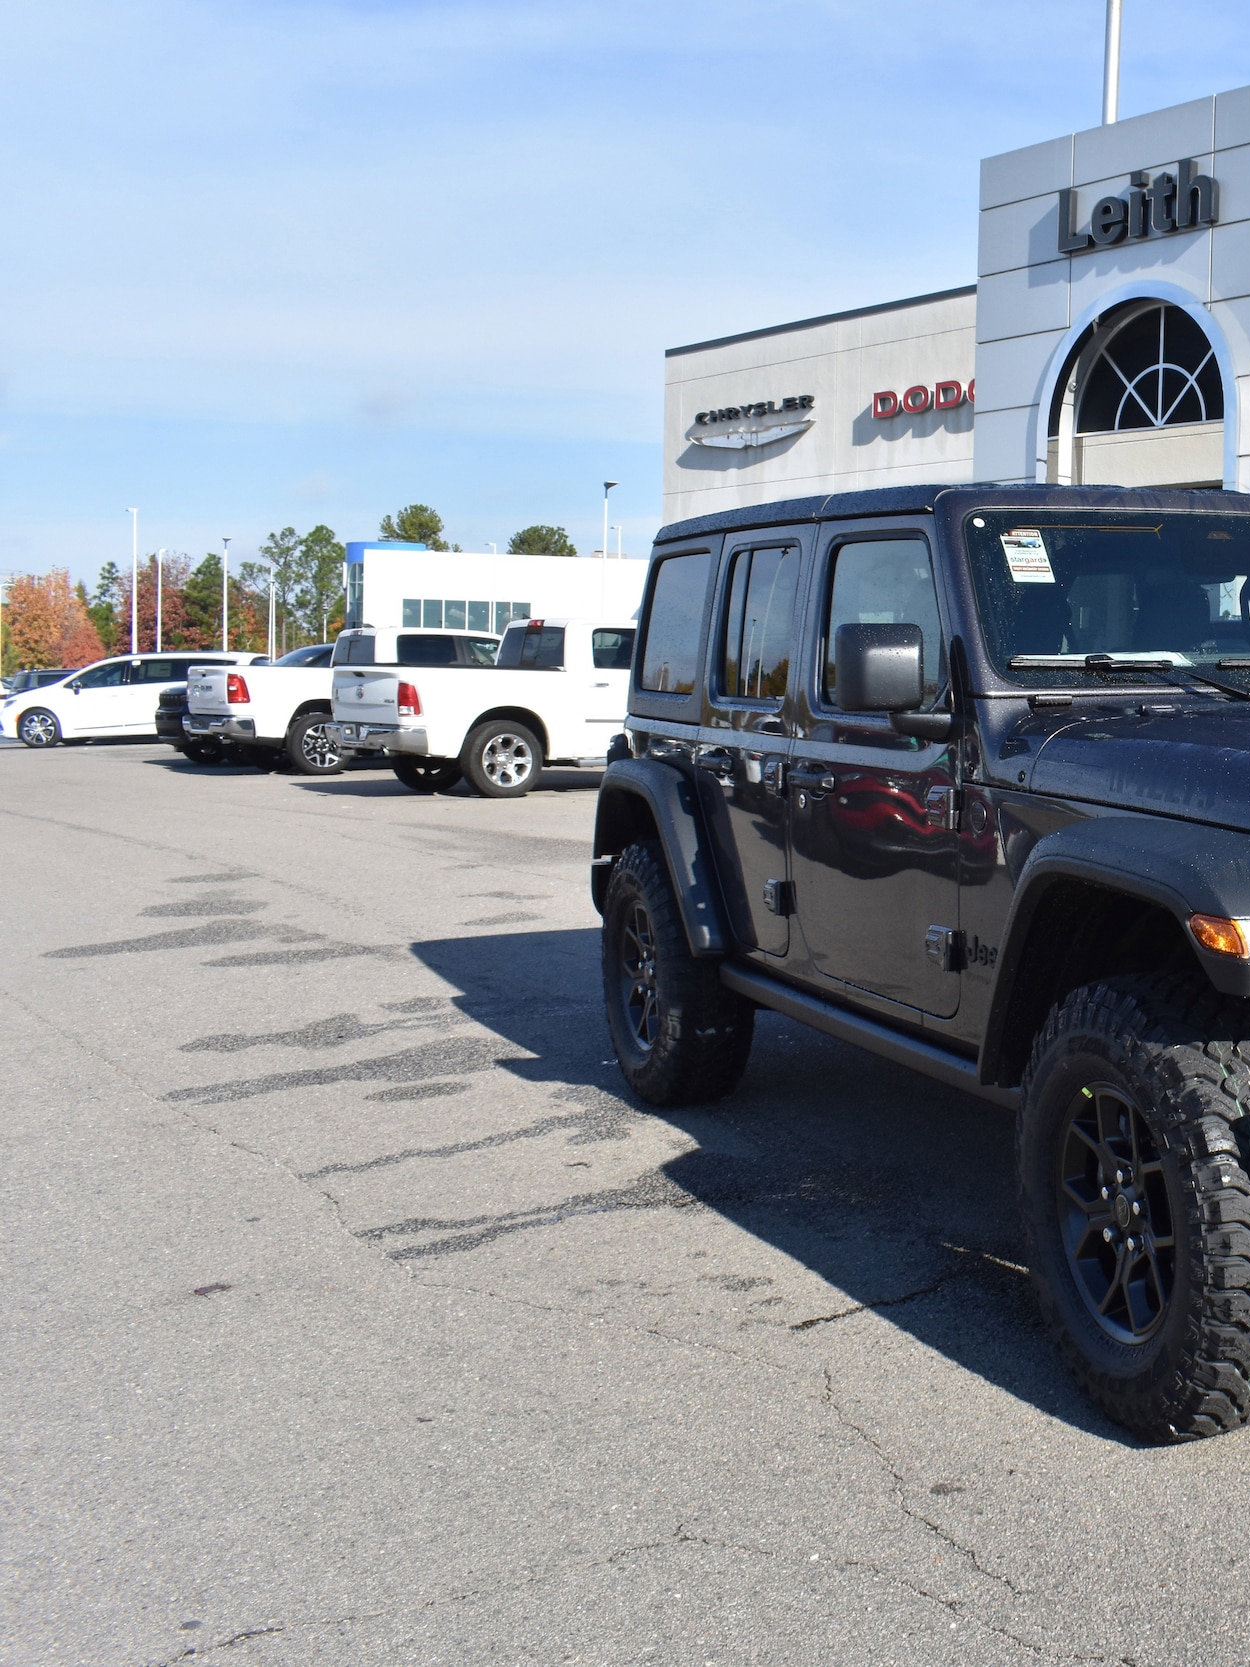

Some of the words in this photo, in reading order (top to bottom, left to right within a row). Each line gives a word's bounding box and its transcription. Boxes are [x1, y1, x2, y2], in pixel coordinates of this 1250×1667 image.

[1058, 158, 1219, 253] Leith
[695, 394, 815, 425] CHRYSLER
[871, 379, 976, 418] DOD
